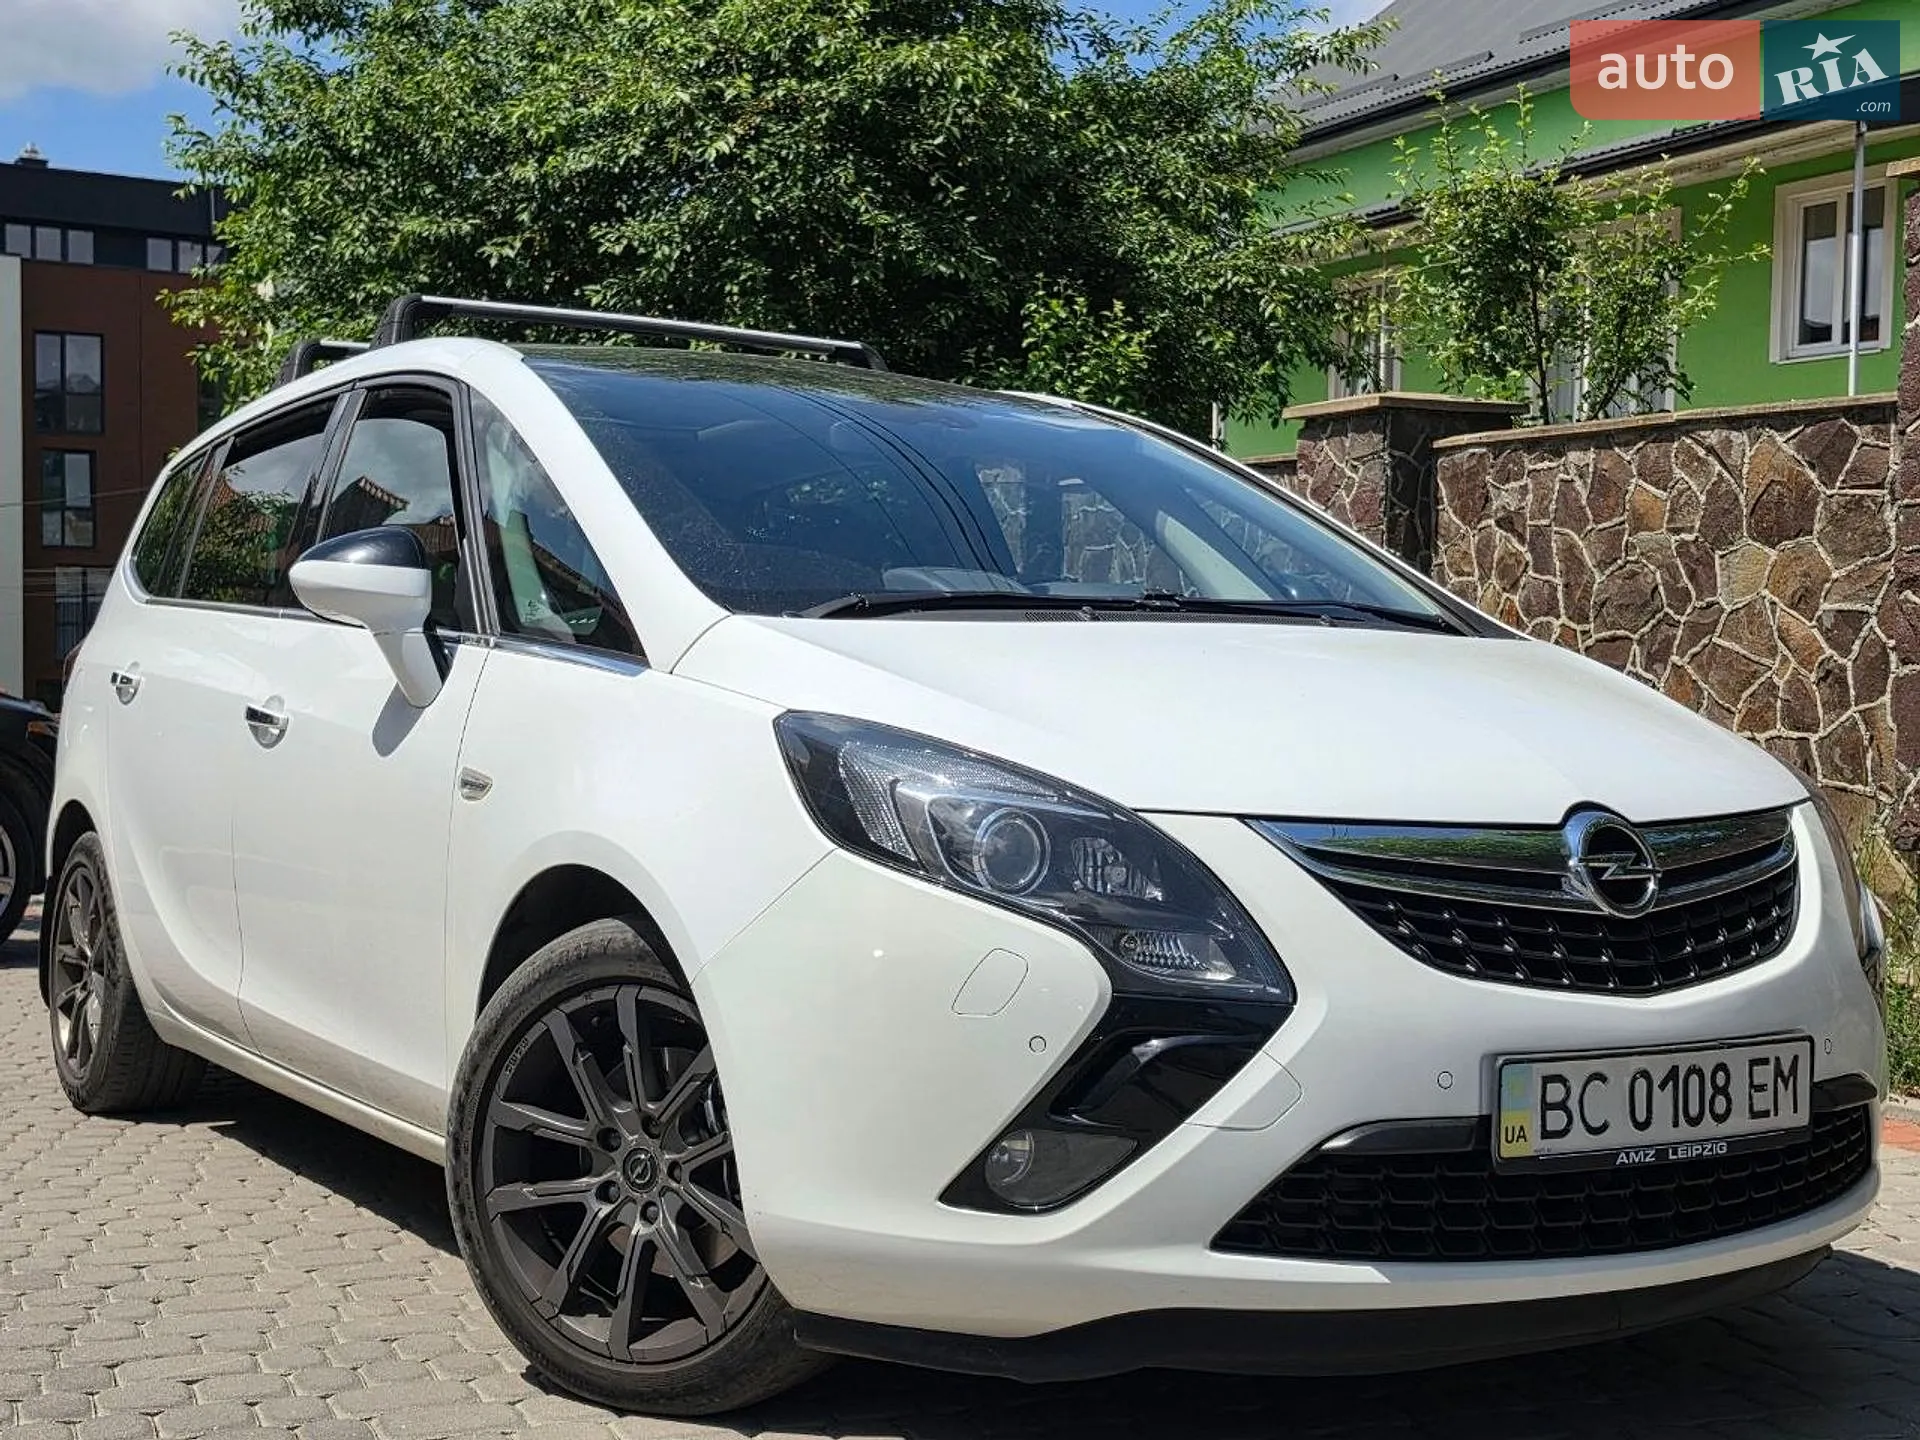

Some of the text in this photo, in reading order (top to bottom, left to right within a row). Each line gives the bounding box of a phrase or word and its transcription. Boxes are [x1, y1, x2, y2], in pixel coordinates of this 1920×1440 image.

[1540, 1054, 1799, 1140] BC 0108 EM
[1504, 1124, 1528, 1144] UA
[1616, 1142, 1728, 1165] AMZ LEIPZIG
